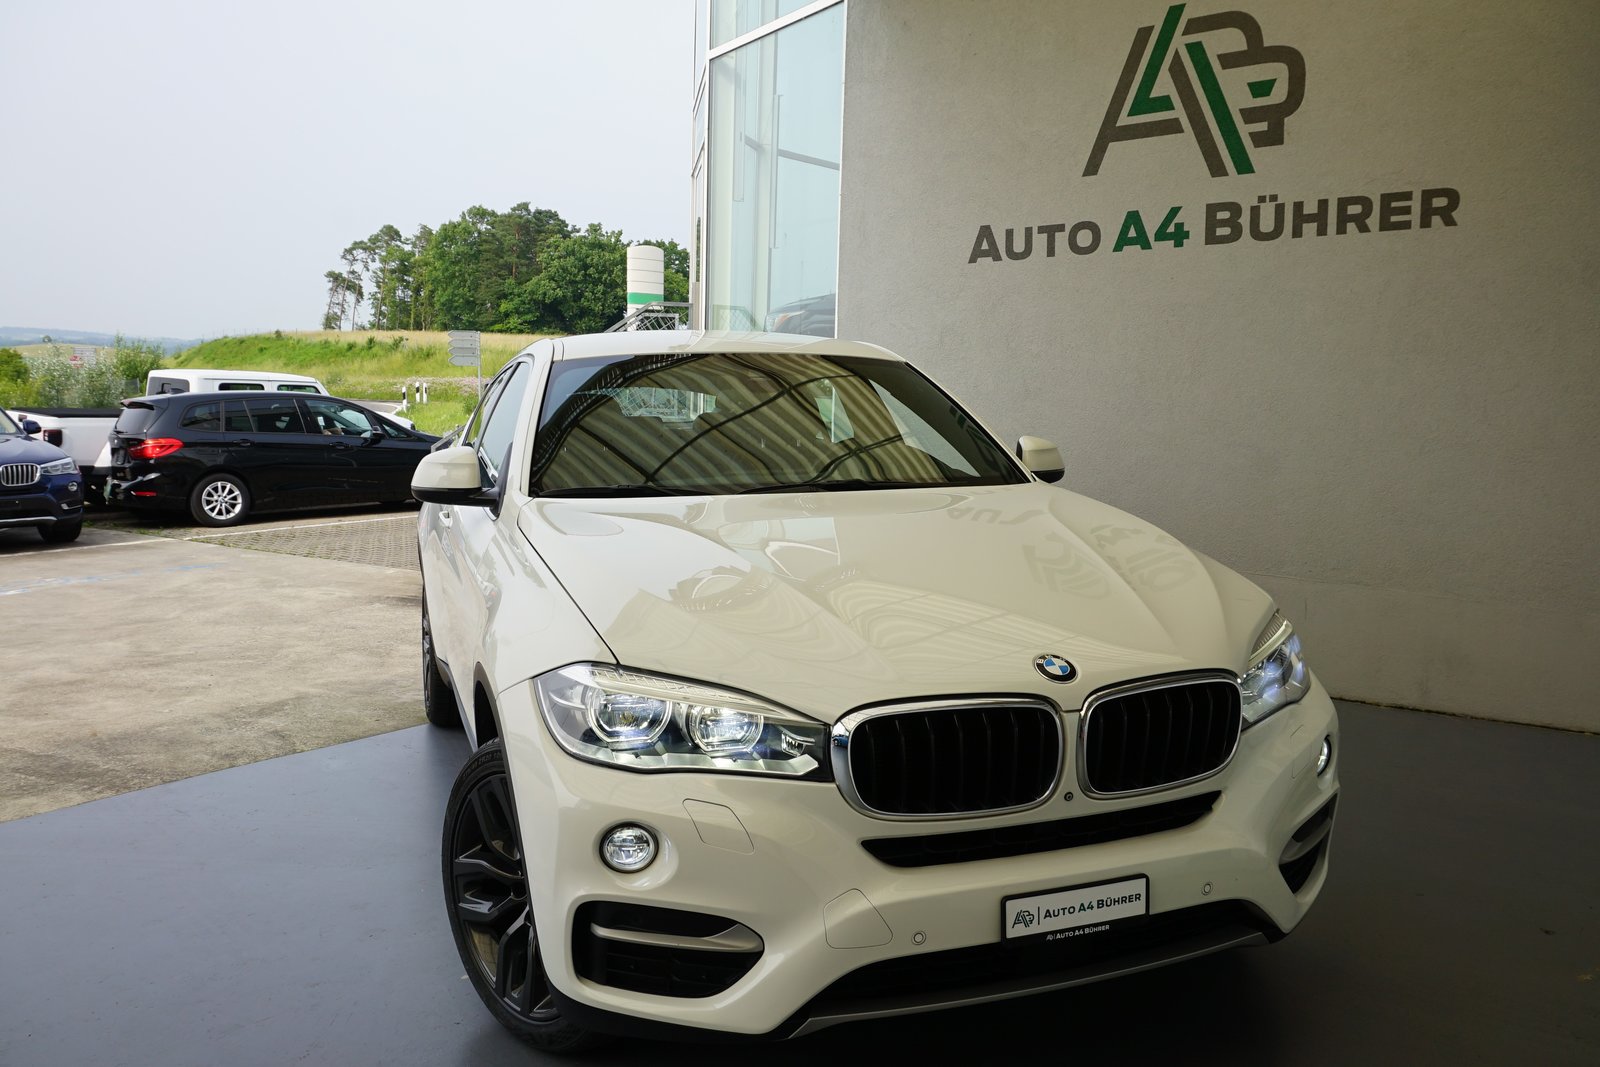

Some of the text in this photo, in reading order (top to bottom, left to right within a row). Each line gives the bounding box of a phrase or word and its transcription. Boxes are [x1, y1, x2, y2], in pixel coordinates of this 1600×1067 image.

[968, 188, 1461, 264] AUTO A4 BÜHRER
[1043, 905, 1075, 920] AUTO
[1078, 900, 1094, 913] A4
[1096, 893, 1142, 909] BÜHRER
[1055, 931, 1074, 939] AUTO
[1074, 928, 1084, 936] A4
[1084, 924, 1110, 934] BÜHRER
